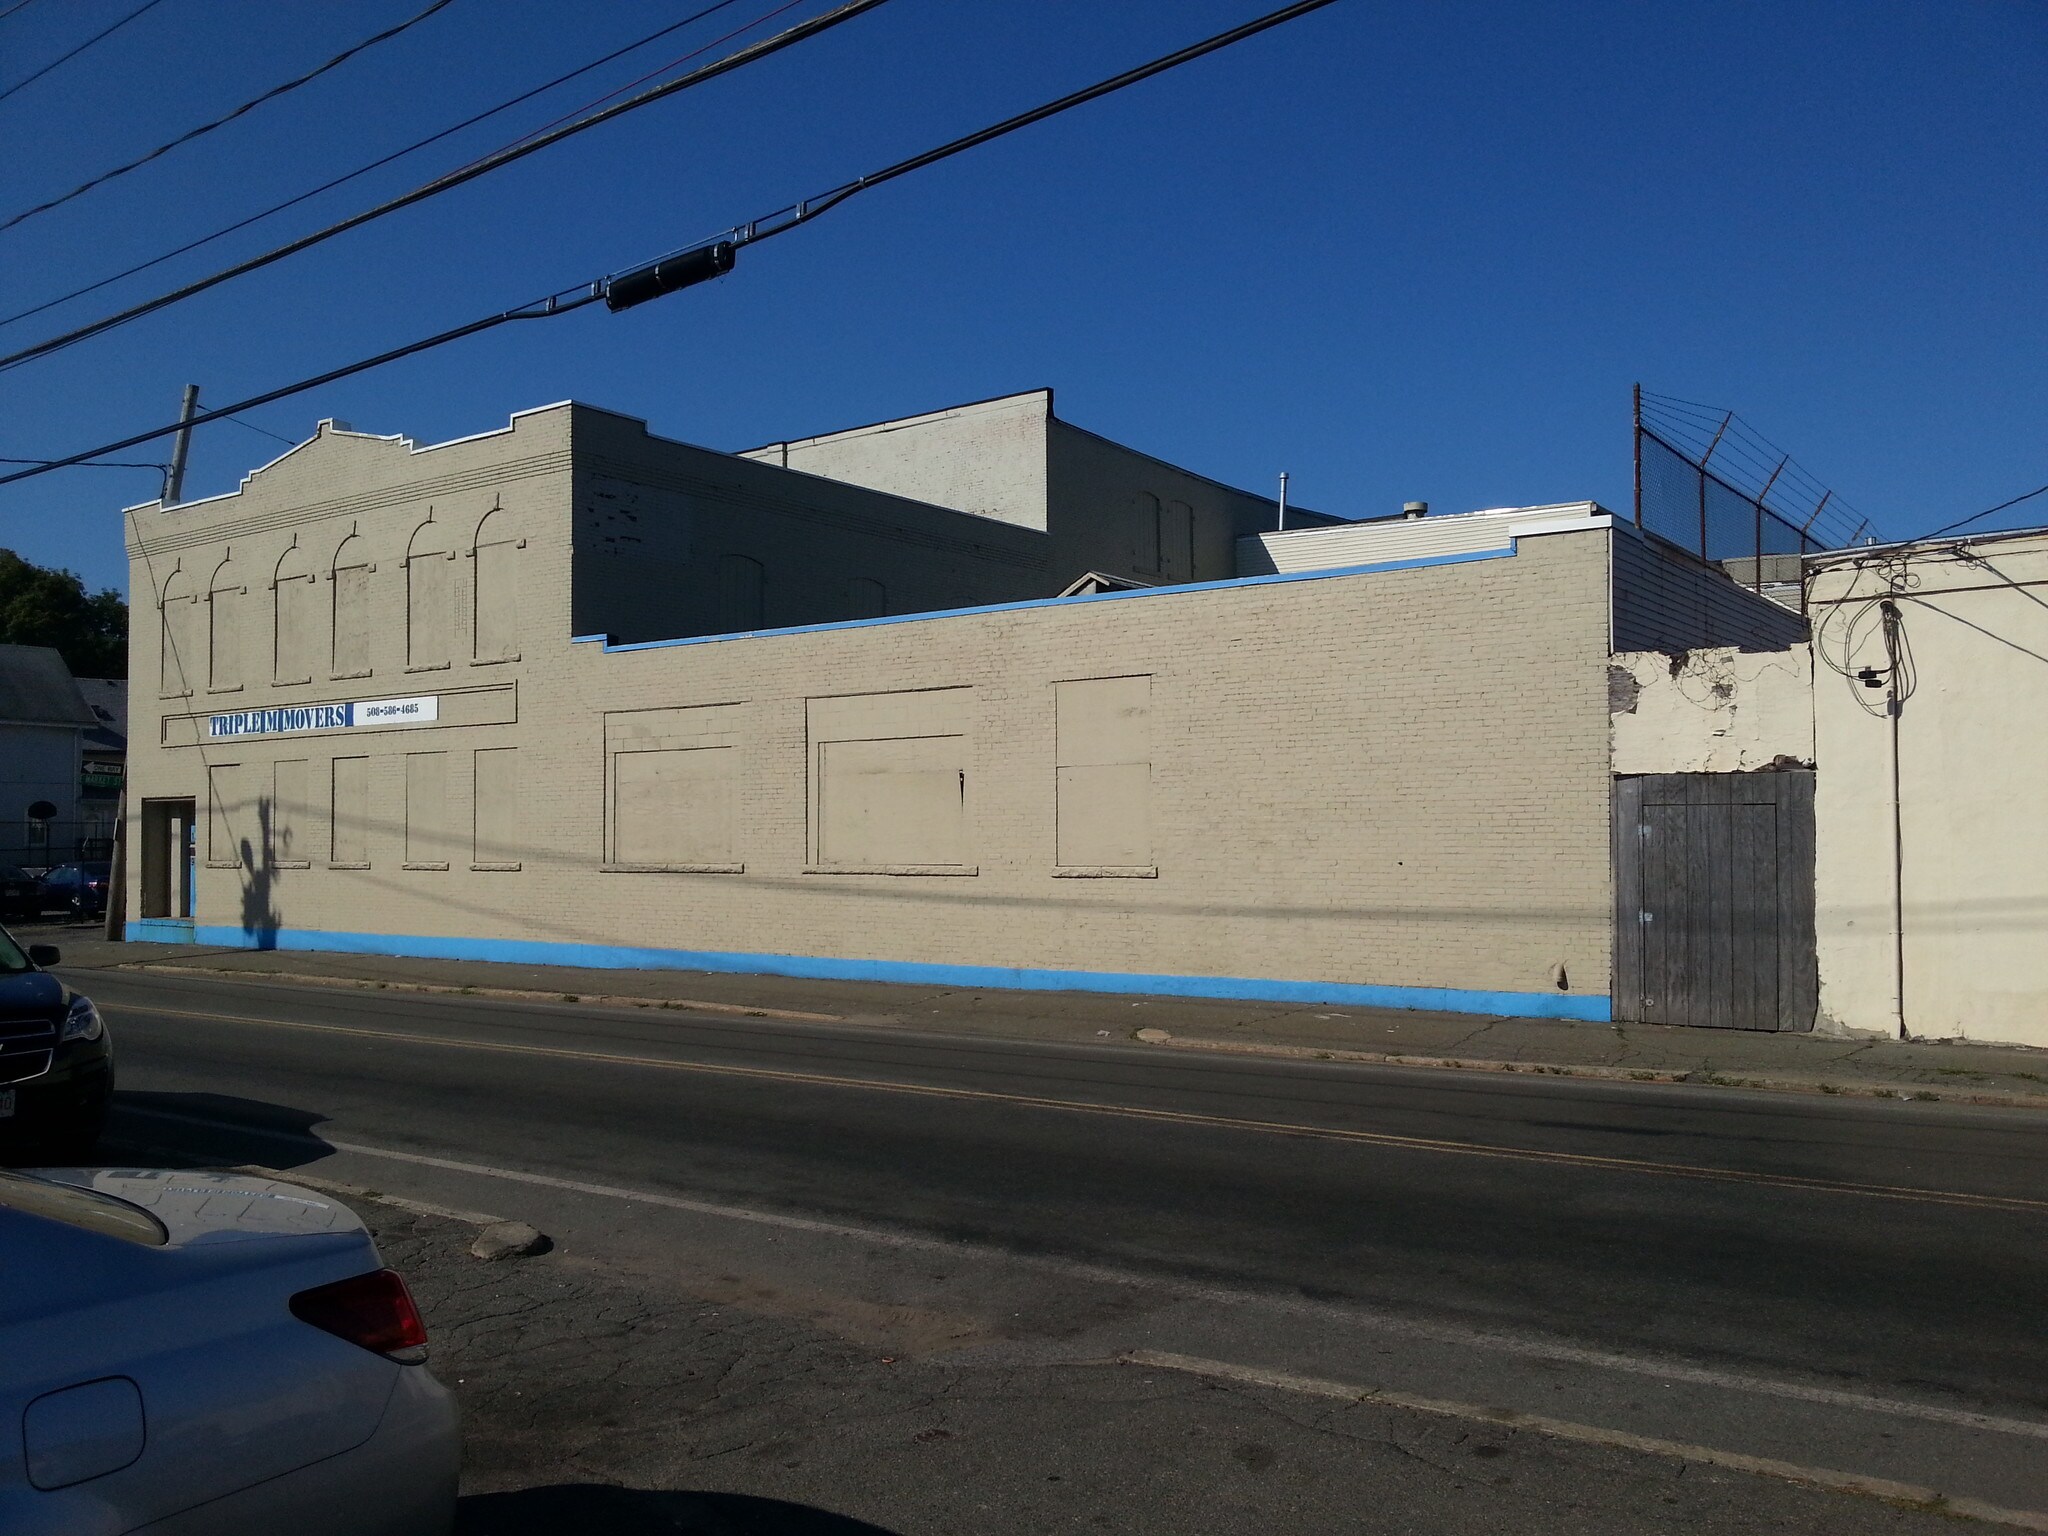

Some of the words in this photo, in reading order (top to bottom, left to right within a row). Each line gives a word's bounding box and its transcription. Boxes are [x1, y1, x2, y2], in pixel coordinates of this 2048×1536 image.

[210, 712, 260, 736] TRIPLE
[266, 710, 278, 731] M
[284, 705, 345, 729] MOVERS
